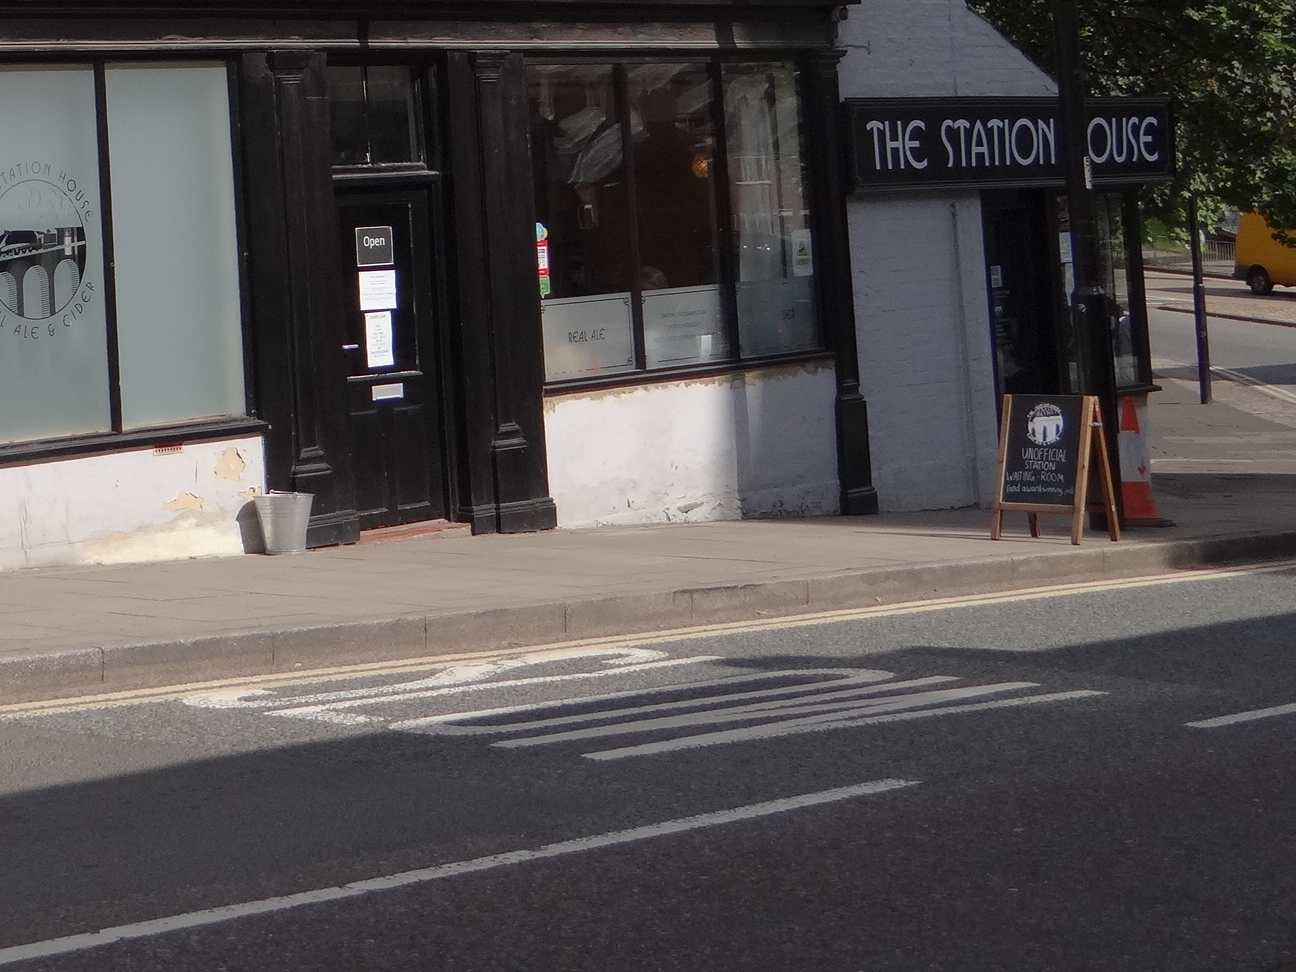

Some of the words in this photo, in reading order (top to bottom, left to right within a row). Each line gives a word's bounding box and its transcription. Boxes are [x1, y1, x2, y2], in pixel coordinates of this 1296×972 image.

[866, 118, 928, 171] THE
[940, 116, 1056, 169] STATION
[1087, 115, 1160, 165] OUSE
[58, 169, 95, 223] HOUSE
[363, 235, 386, 249] Open
[13, 324, 40, 340] ALE
[47, 323, 55, 337] &
[62, 280, 96, 328] CIDER
[567, 330, 588, 344] REAL
[591, 327, 606, 340] ALE
[1021, 447, 1067, 462] UNOFFICIAL
[1024, 460, 1057, 471] STATION
[1006, 470, 1036, 482] WAITING
